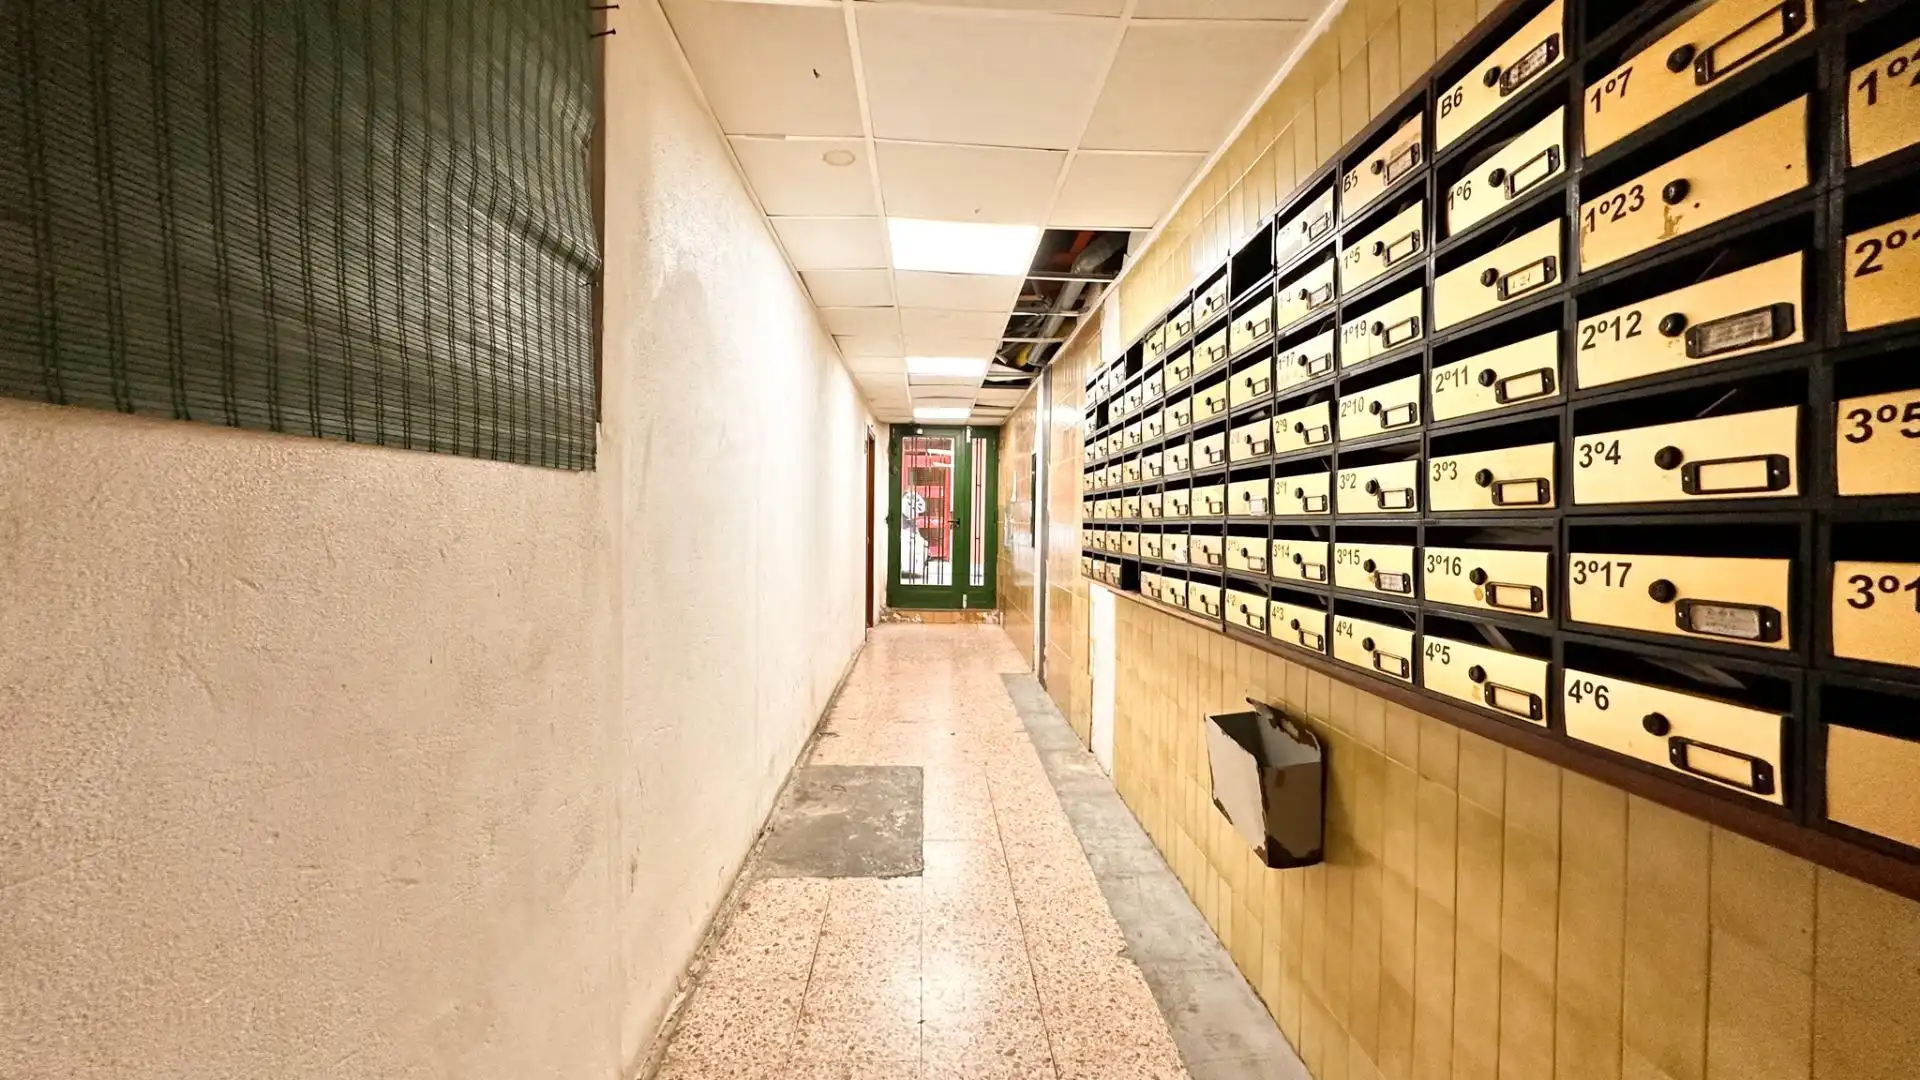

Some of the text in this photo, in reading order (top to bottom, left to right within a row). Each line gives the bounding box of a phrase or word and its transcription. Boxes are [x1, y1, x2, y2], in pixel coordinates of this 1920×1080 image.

[1590, 66, 1634, 113] 1º7
[1440, 86, 1464, 119] B6
[1343, 170, 1359, 194] B5
[1447, 180, 1472, 211] 1º6
[1585, 184, 1646, 233] 1º23
[1343, 246, 1361, 270] 1º5
[1343, 319, 1368, 344] 1º19
[1582, 310, 1643, 351] 2º12
[1434, 365, 1470, 393] 2º11
[1340, 396, 1365, 418] 2º10
[1274, 417, 1288, 434] 2º9
[1844, 401, 1920, 444] 3º5
[1579, 439, 1622, 468] 3º4
[1339, 473, 1357, 490] 3º2
[1432, 461, 1458, 482] 3º3
[1337, 548, 1361, 565] 3º15
[1426, 553, 1462, 577] 3º16
[1572, 560, 1633, 588] 3º17
[1271, 603, 1285, 621] 4º3
[1336, 619, 1354, 638] 4º4
[1425, 641, 1451, 665] 4º5
[1567, 678, 1610, 711] 4º6
